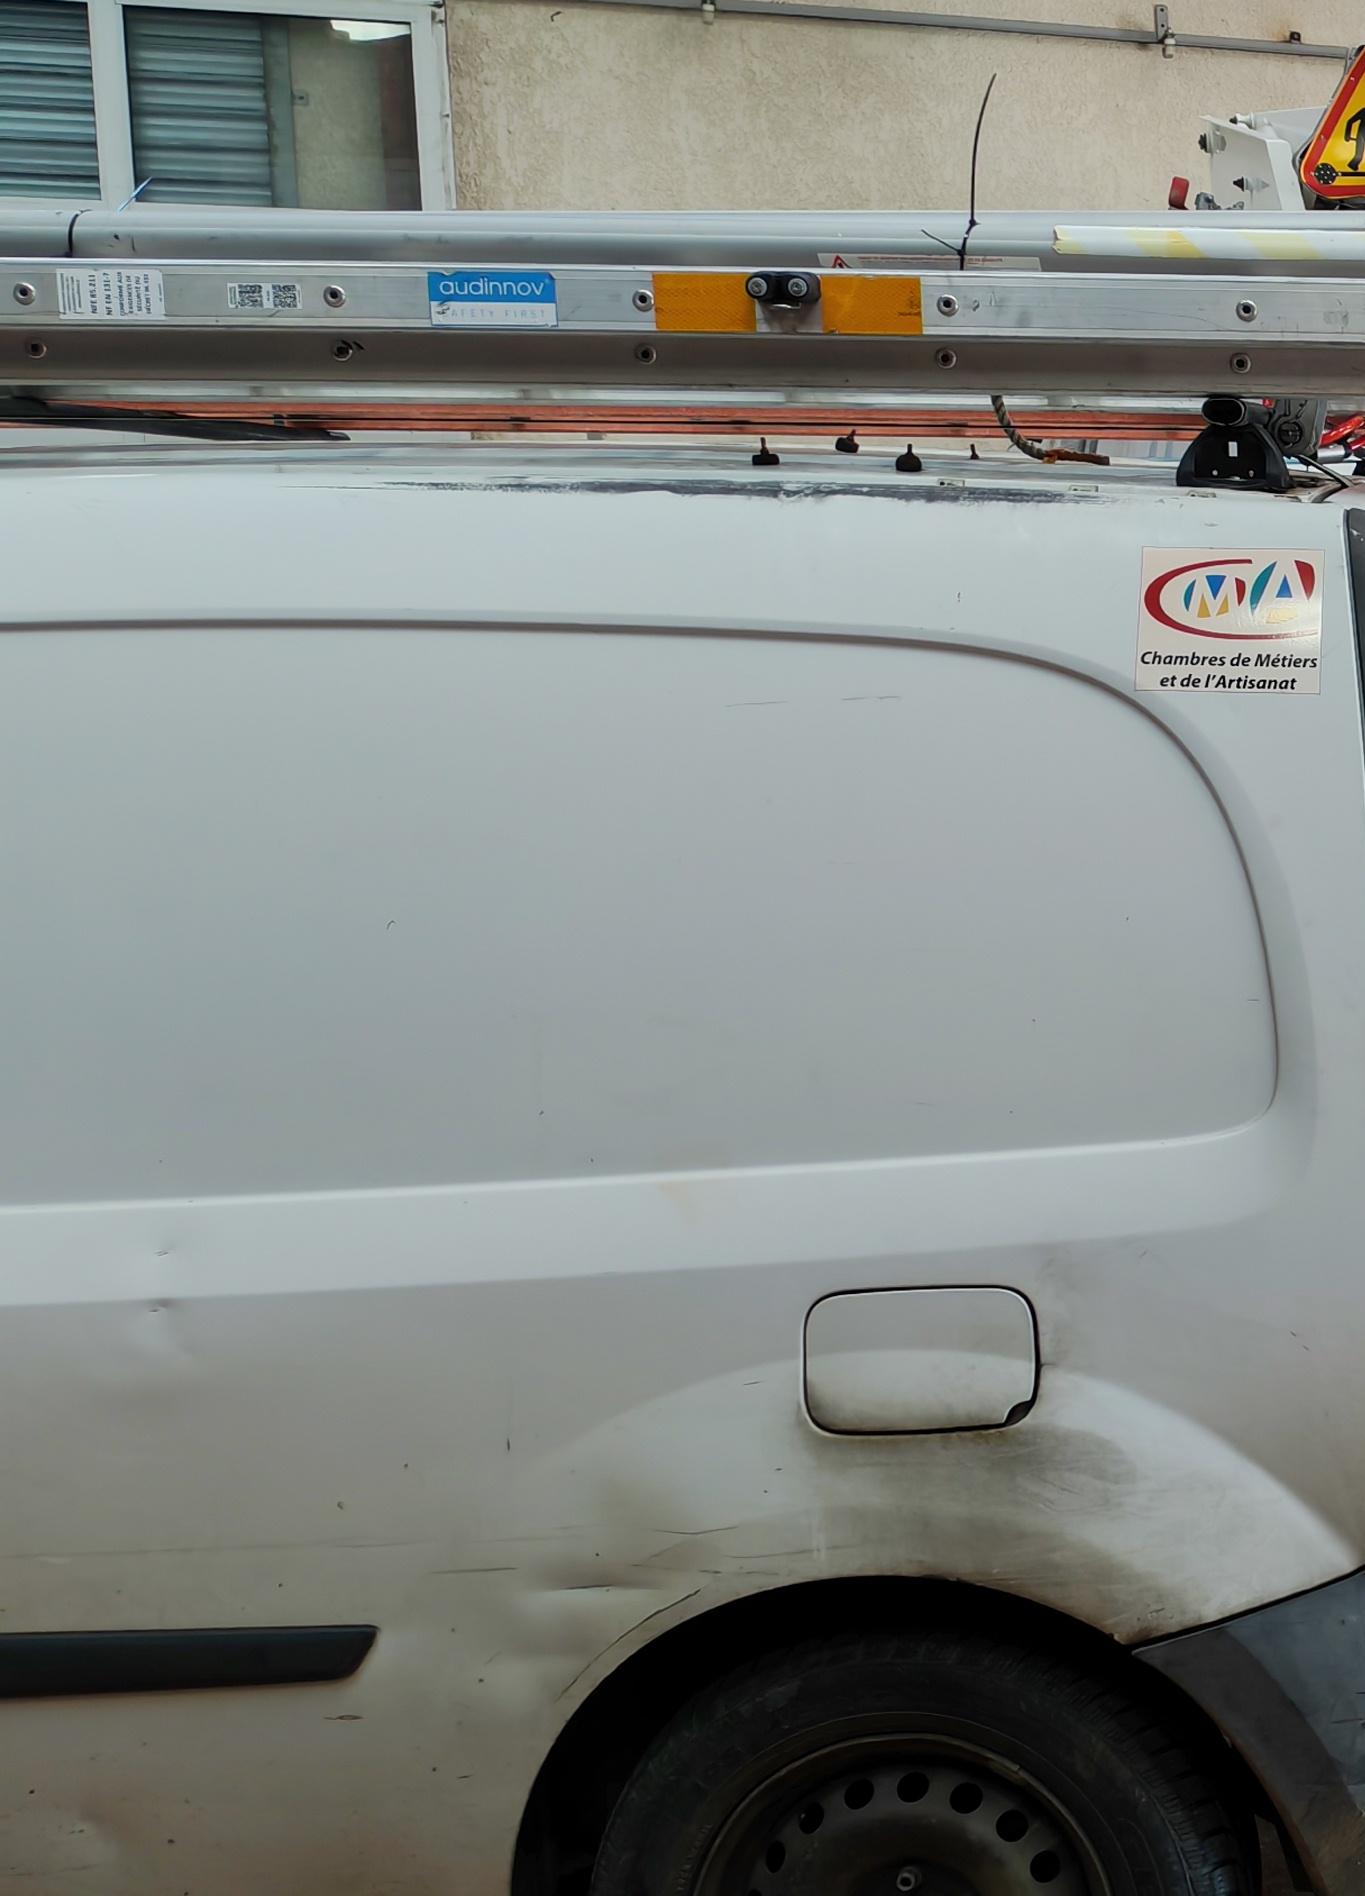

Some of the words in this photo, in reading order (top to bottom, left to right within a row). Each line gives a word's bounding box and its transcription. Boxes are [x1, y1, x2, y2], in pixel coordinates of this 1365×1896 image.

[439, 277, 544, 296] audinnov
[1140, 651, 1226, 667] Chambres
[1230, 652, 1251, 667] de
[1254, 652, 1318, 669] Métiers
[1159, 674, 1177, 688] et
[1180, 673, 1201, 688] de
